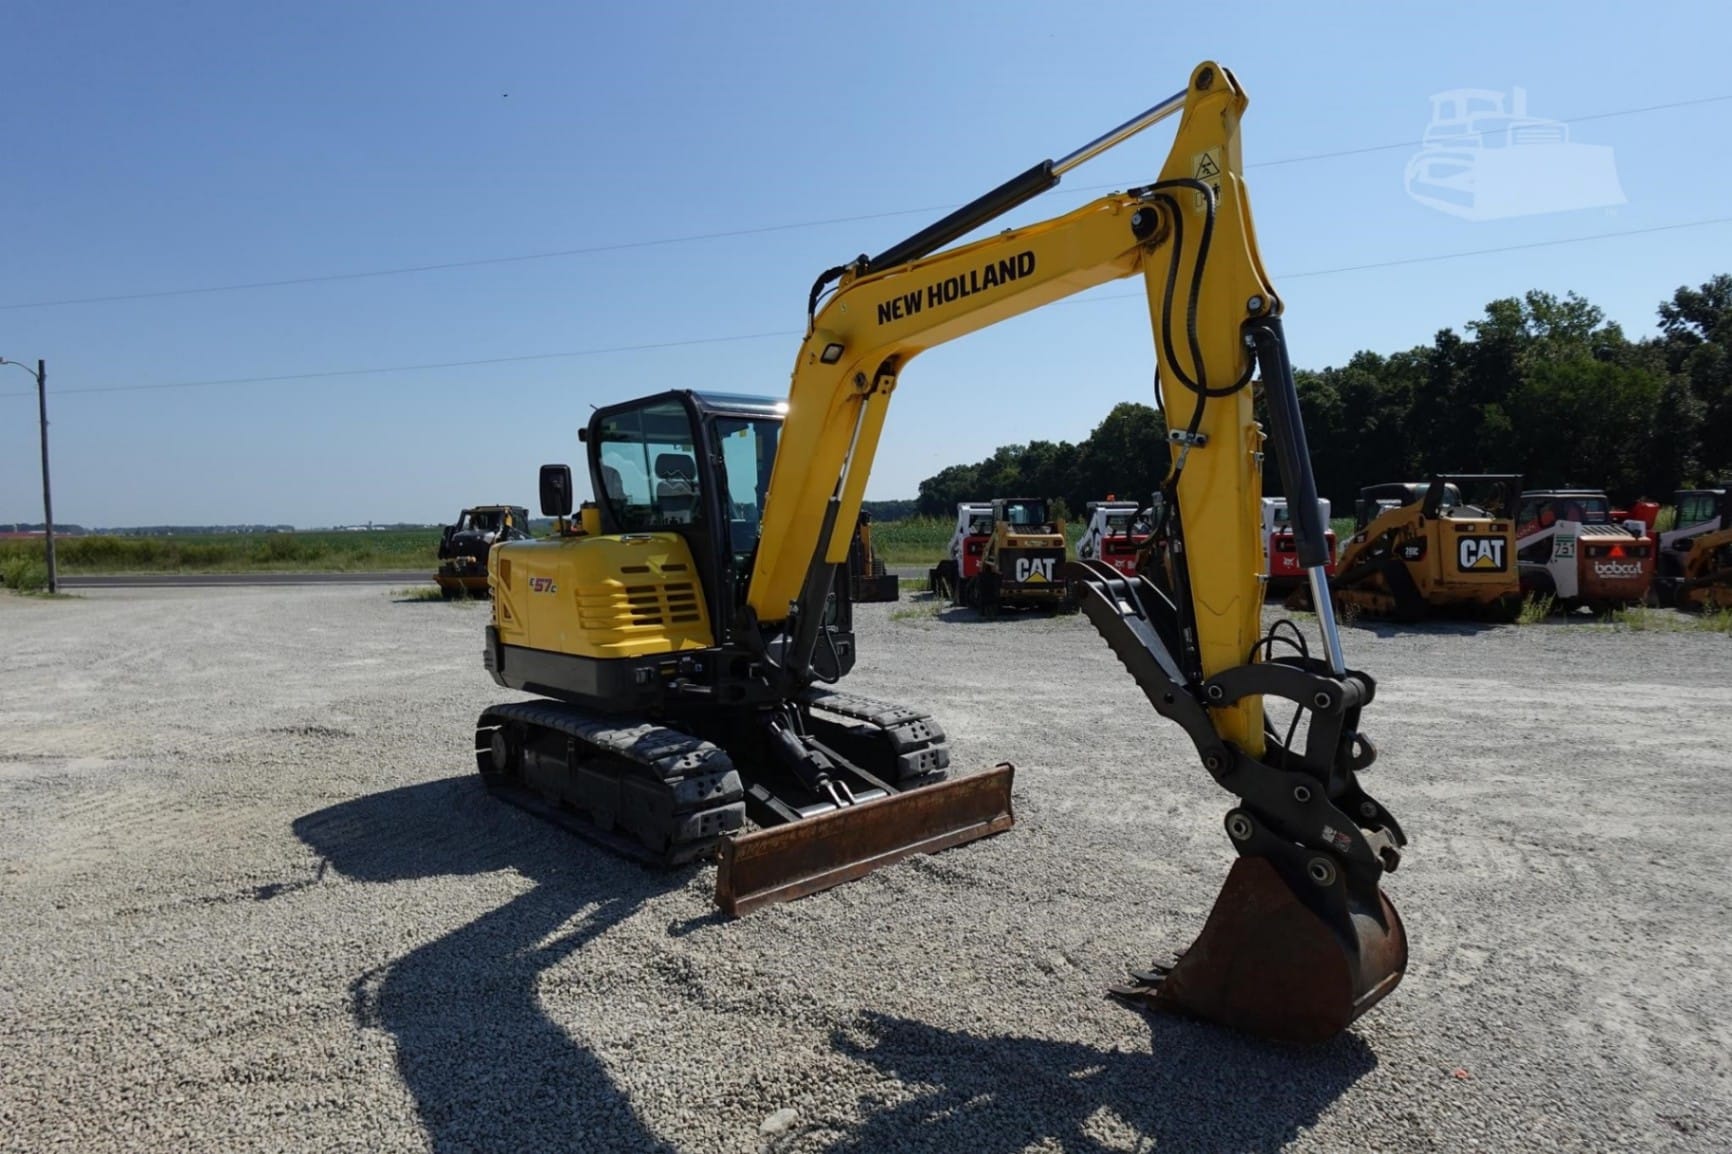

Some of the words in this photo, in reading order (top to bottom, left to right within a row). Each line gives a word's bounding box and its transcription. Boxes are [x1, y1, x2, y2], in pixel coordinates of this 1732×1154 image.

[878, 290, 923, 325] NEW
[928, 250, 1036, 308] HOLLAND
[1461, 539, 1504, 567] CAT
[1016, 558, 1055, 582] CAT
[1594, 560, 1643, 574] bobcat
